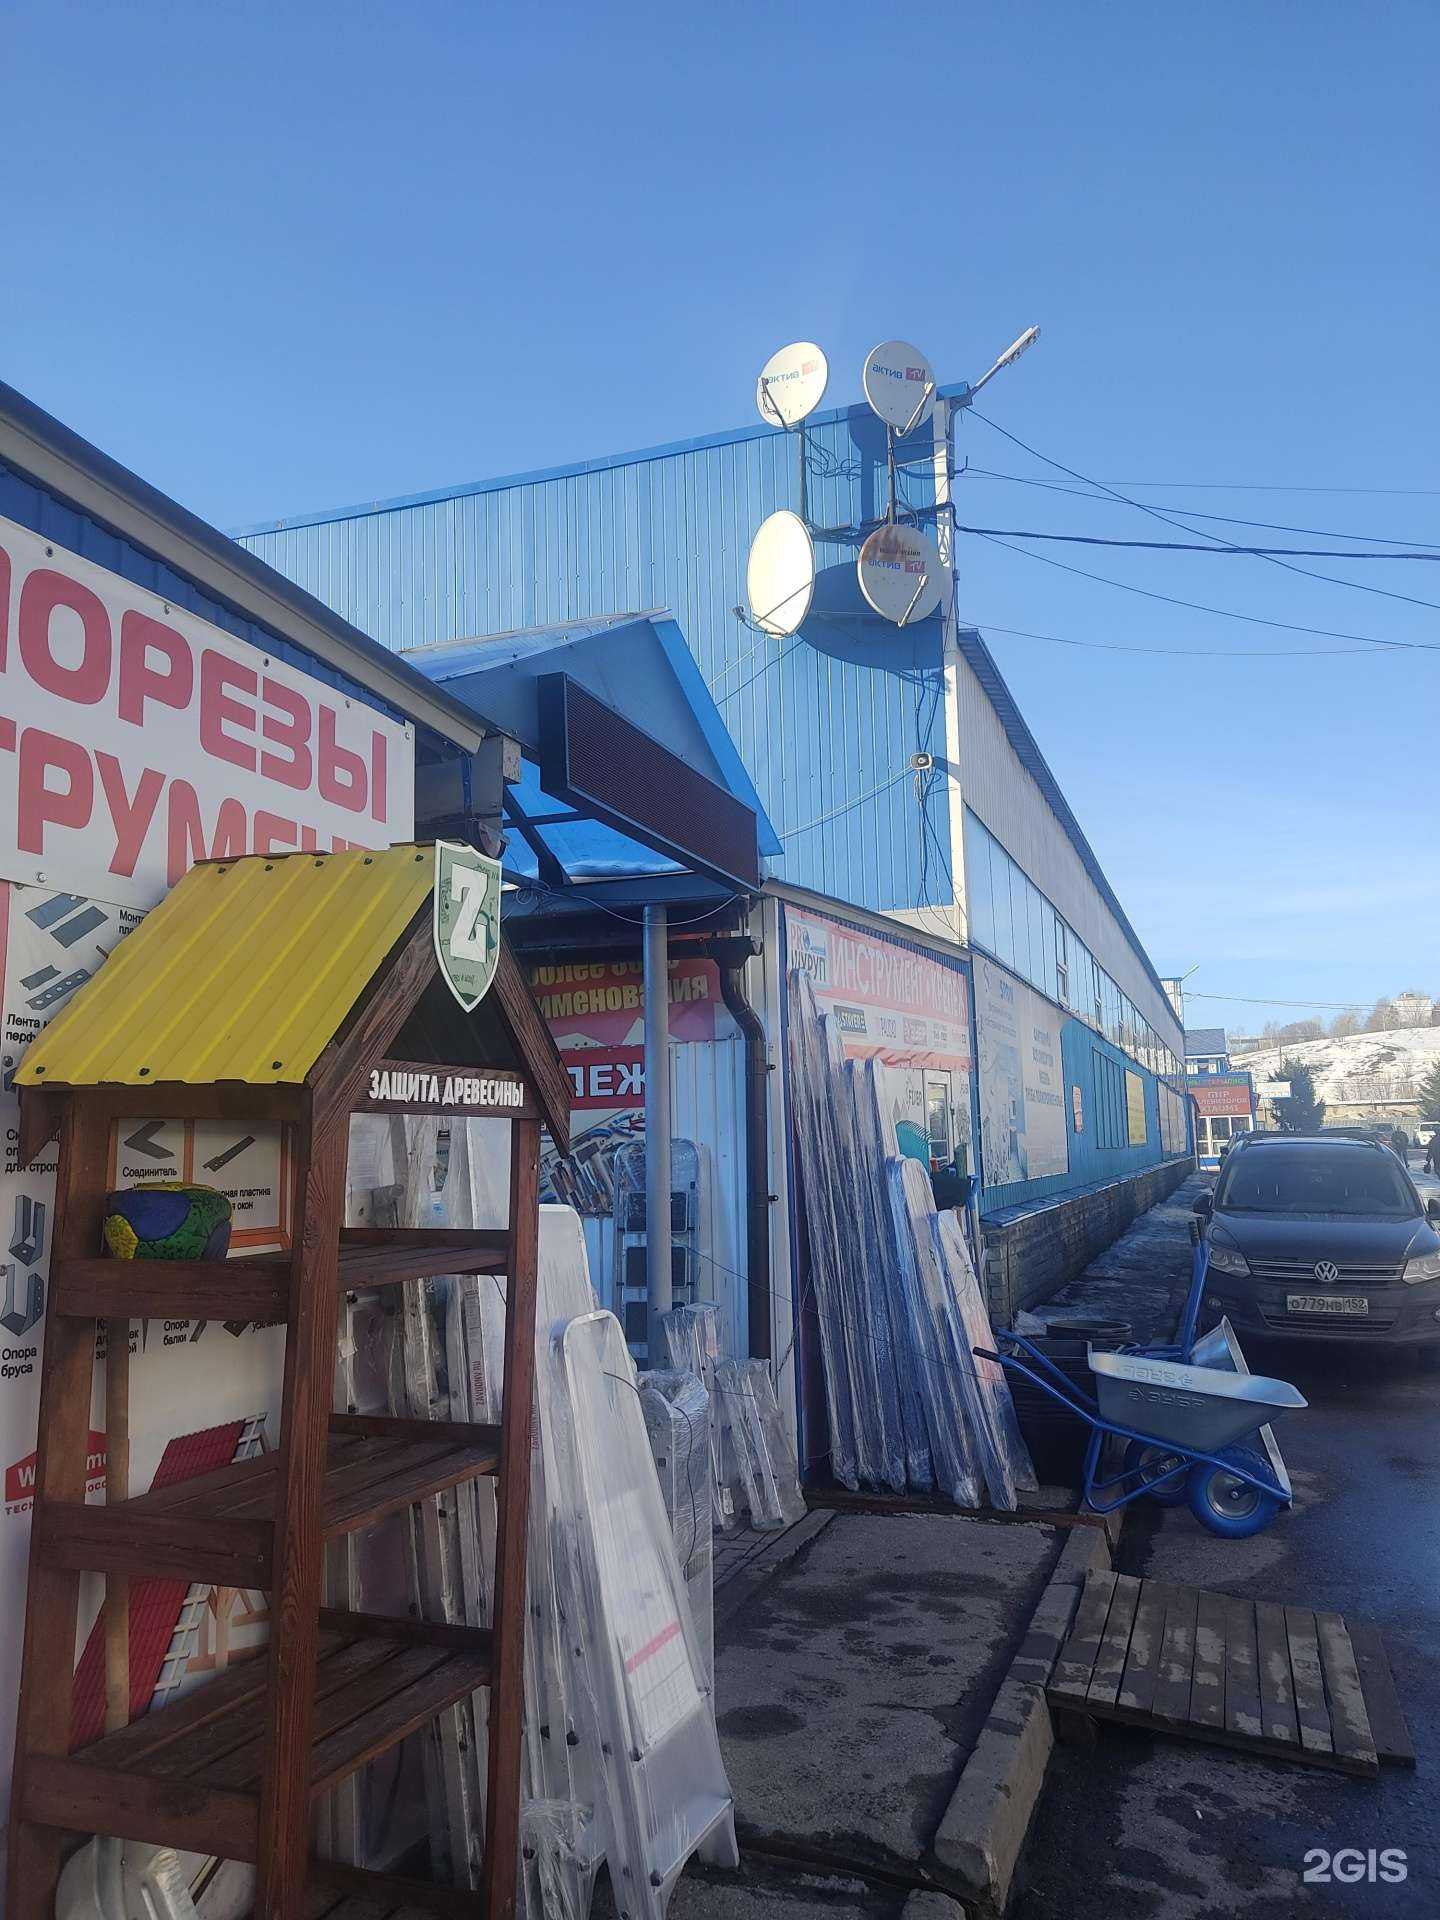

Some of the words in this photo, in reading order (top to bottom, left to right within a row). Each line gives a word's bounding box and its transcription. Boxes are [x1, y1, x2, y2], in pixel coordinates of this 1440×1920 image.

[0, 545, 387, 824] ОРЕЗЫ
[831, 934, 923, 1006] ИНСТРУМЕНТ
[369, 1069, 440, 1103] ЗАЩИТА
[442, 1076, 524, 1107] ДРЕВЕСИНЫ
[122, 1166, 178, 1178] Соединитель
[239, 1188, 271, 1197] пластина
[163, 1334, 187, 1346] балки
[2, 1347, 37, 1361] Опора
[1, 1363, 33, 1379] бруса
